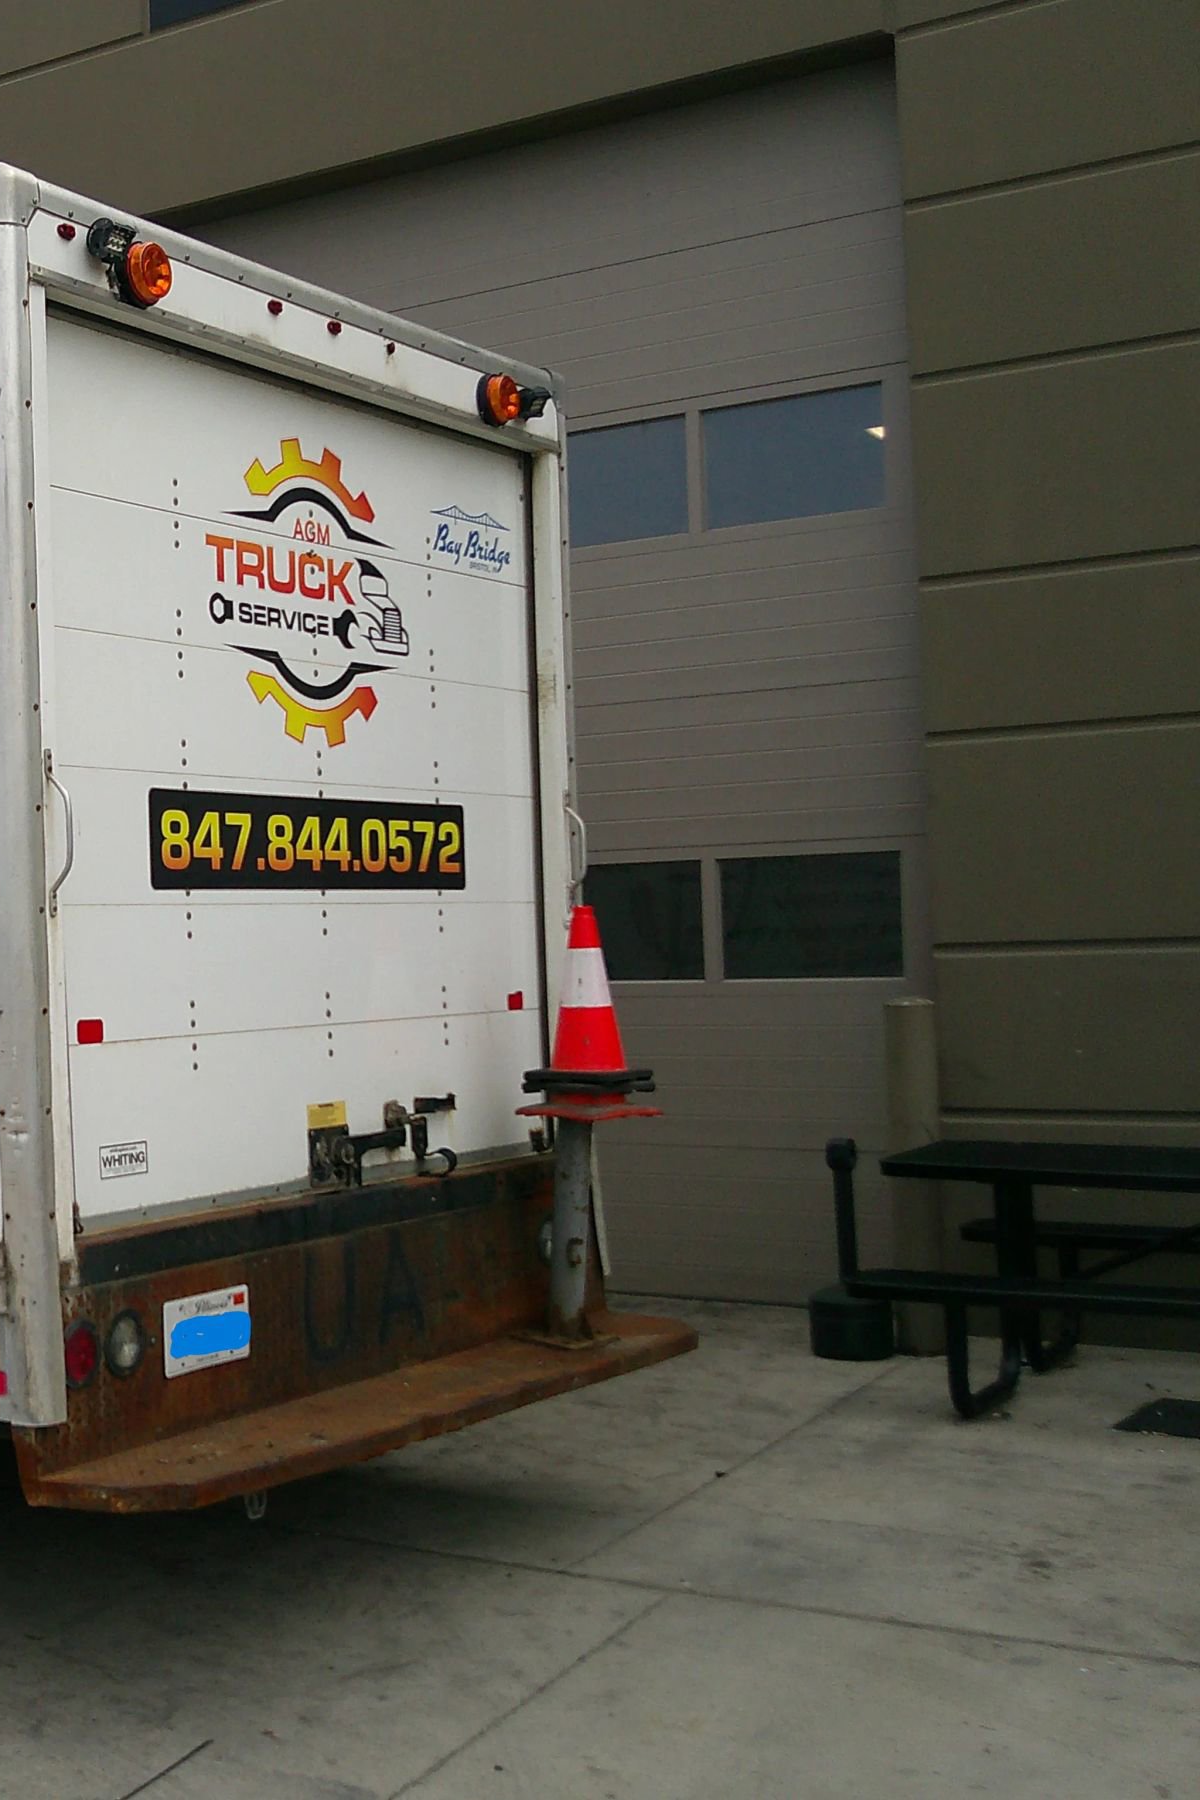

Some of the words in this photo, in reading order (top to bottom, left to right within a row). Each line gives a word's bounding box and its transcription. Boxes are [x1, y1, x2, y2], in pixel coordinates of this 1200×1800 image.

[293, 520, 330, 545] AGM
[433, 523, 462, 564] Bay
[464, 530, 510, 573] Bridge
[205, 534, 356, 605] TRUCK
[238, 603, 329, 636] SERVICE
[161, 809, 460, 872] 847.844.0572
[102, 1151, 145, 1168] WHITING
